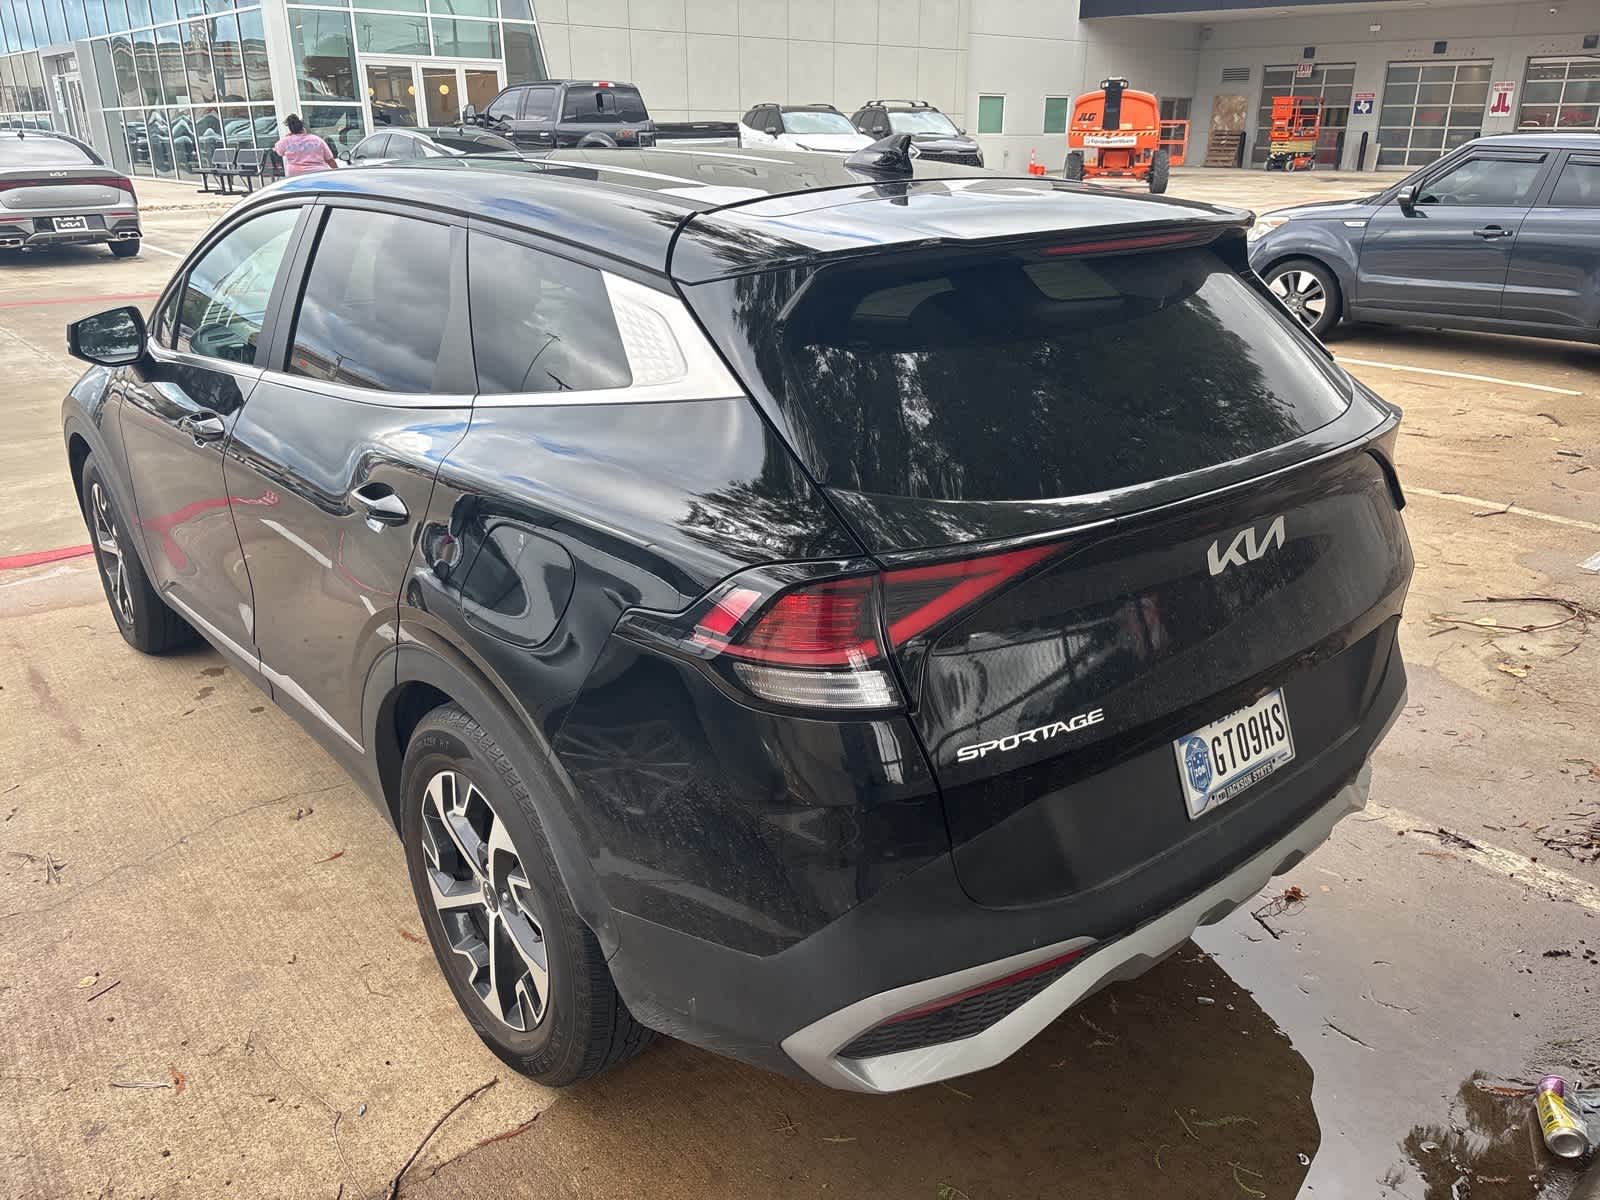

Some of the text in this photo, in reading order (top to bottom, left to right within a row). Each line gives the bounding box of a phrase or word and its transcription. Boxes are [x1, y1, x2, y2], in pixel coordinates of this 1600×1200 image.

[1078, 112, 1096, 121] JLG
[1207, 515, 1286, 577] KIA
[957, 708, 1104, 762] SPORTAGE
[1211, 703, 1285, 777] GT09HS
[1253, 763, 1273, 781] STATE
